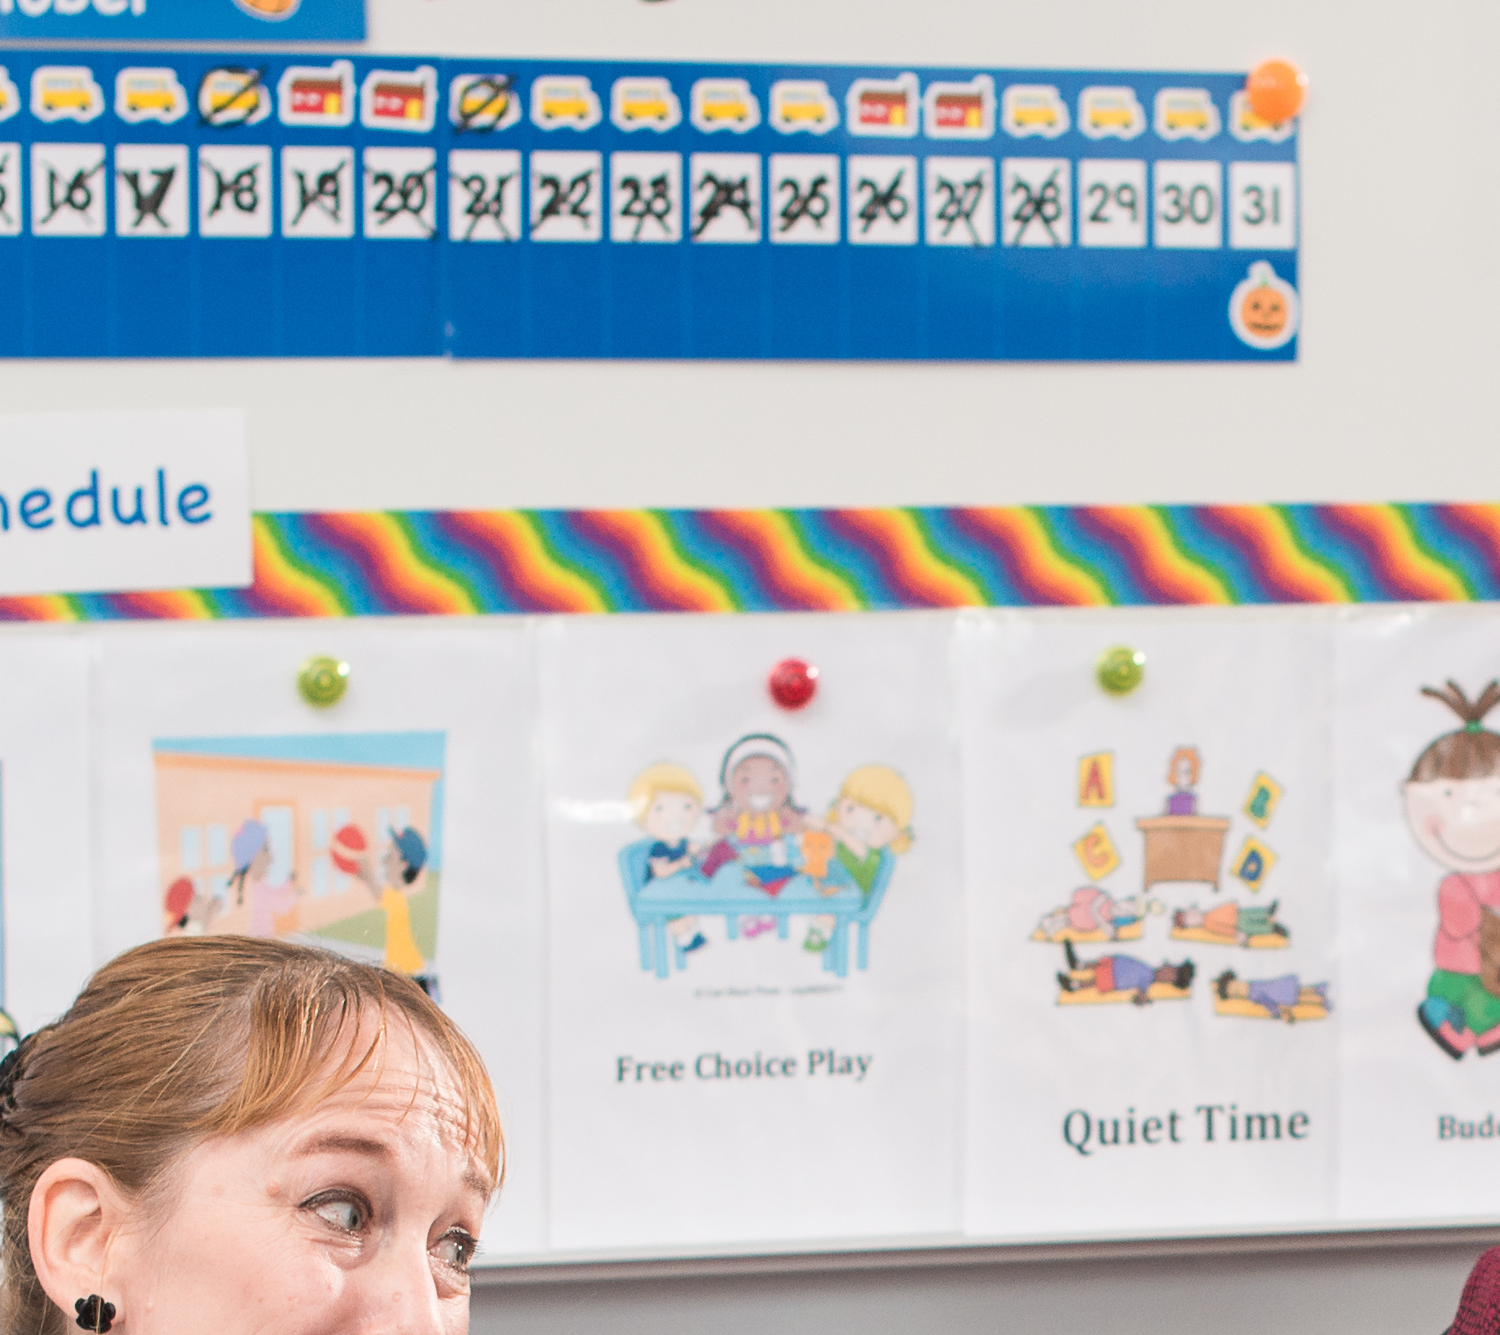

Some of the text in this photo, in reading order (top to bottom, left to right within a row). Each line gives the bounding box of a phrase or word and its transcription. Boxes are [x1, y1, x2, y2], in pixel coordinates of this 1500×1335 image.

[1089, 182, 1137, 222] 29
[1163, 183, 1213, 223] 30
[1243, 184, 1279, 224] 31
[616, 1046, 874, 1085] Free Choice Play
[1062, 1102, 1312, 1157] Quiet Time
